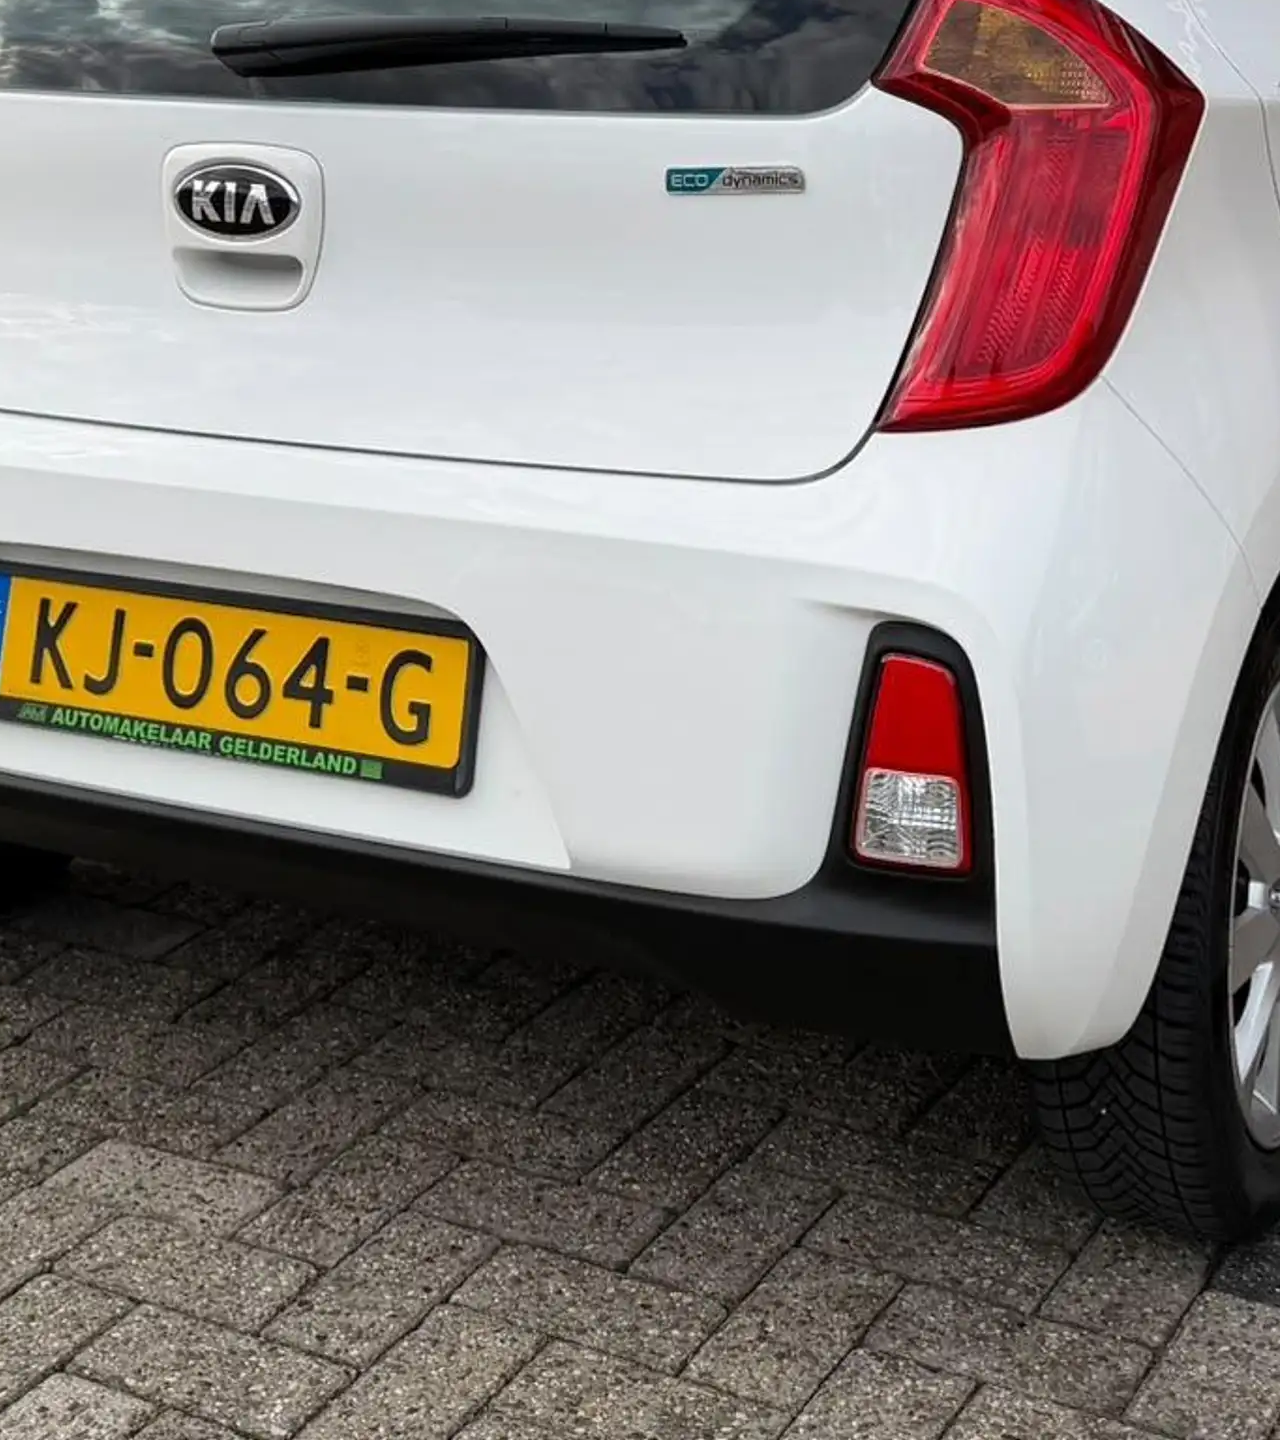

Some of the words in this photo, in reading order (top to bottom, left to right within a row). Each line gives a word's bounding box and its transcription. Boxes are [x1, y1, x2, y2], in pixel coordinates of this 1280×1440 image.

[192, 179, 276, 225] KIA
[671, 173, 709, 188] ECO
[721, 167, 800, 190] dynamics
[29, 596, 435, 747] KJ-064-G
[50, 707, 213, 750] AUTOMAKELAAR
[219, 734, 358, 775] GELDERLAND
